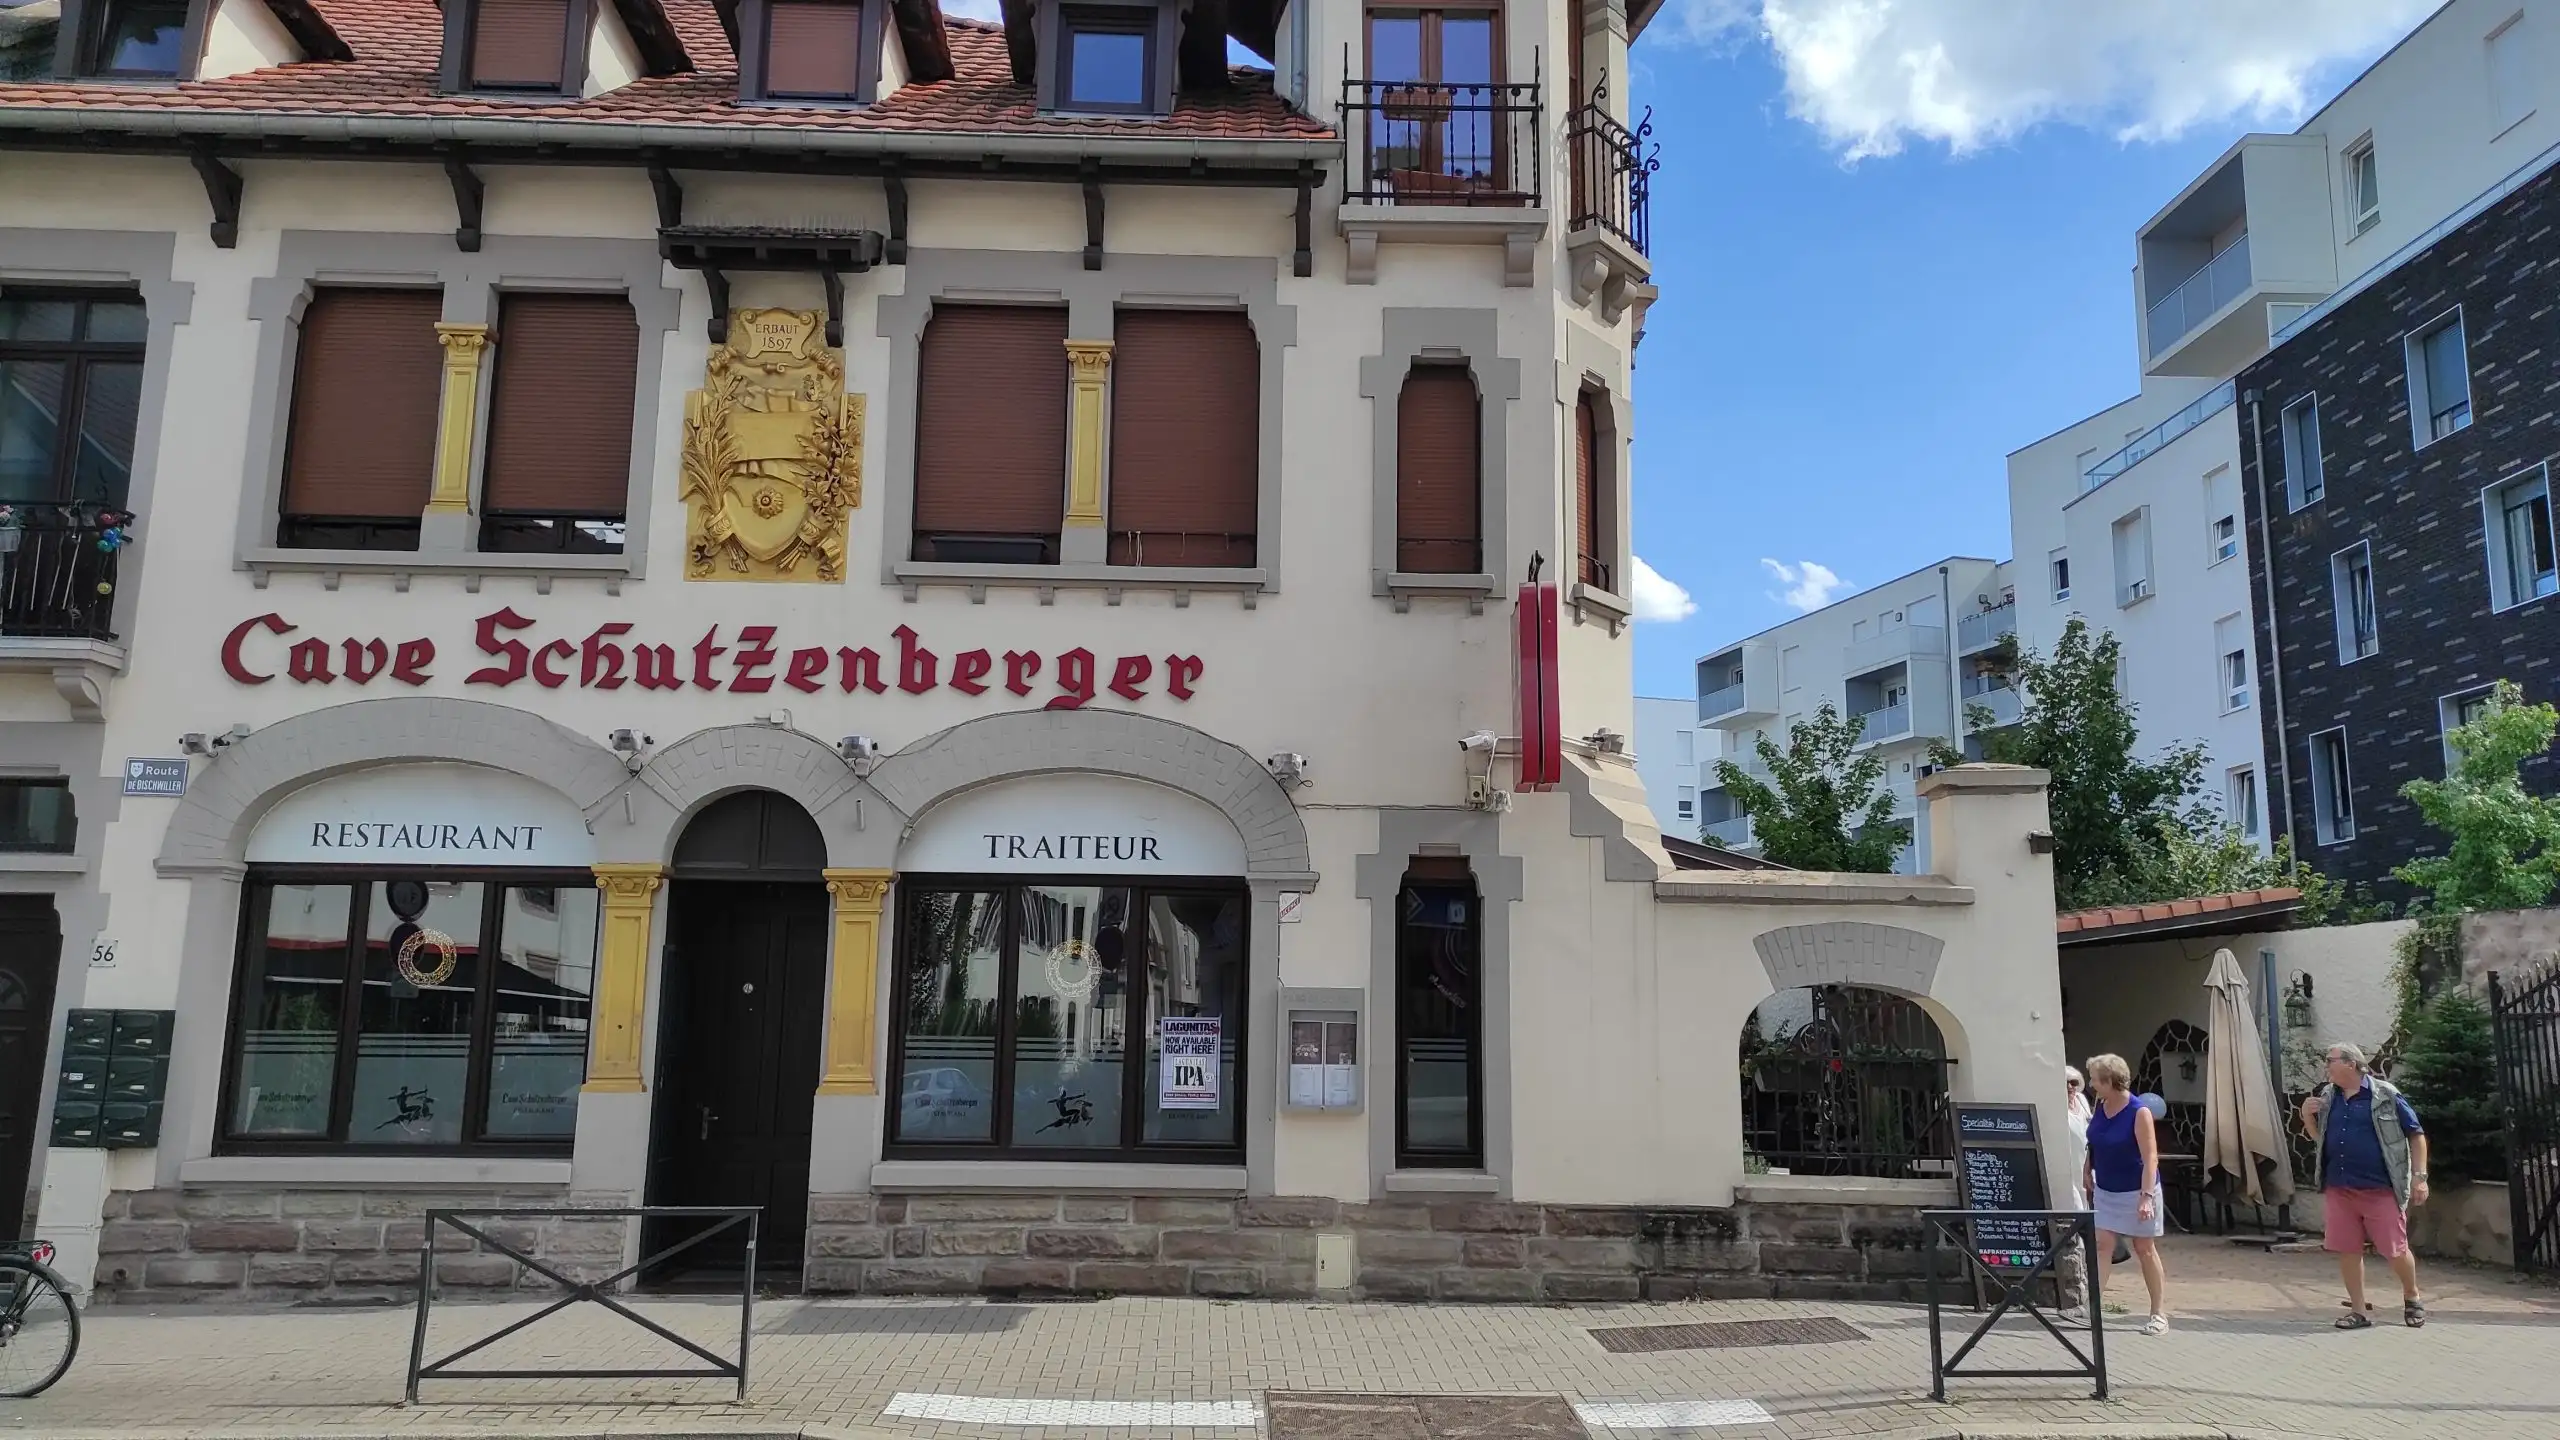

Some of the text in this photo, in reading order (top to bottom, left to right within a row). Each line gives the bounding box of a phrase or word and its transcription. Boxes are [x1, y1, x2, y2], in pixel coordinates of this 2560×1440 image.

[755, 323, 800, 335] ERBAUT
[762, 336, 793, 351] 1897
[221, 606, 1204, 711] Cave Schutzenberger
[145, 766, 179, 776] Route
[127, 779, 182, 791] DE BISCHWILLER
[312, 822, 543, 851] RESTAURANT
[983, 834, 1163, 861] TRAITEUR
[92, 945, 114, 962] 56
[1165, 1022, 1217, 1032] LAGUNITAS
[1165, 1036, 1216, 1045] NOW AVAILABLE
[1165, 1045, 1215, 1054] RIGHT HERE!
[1174, 1065, 1204, 1086] IPA
